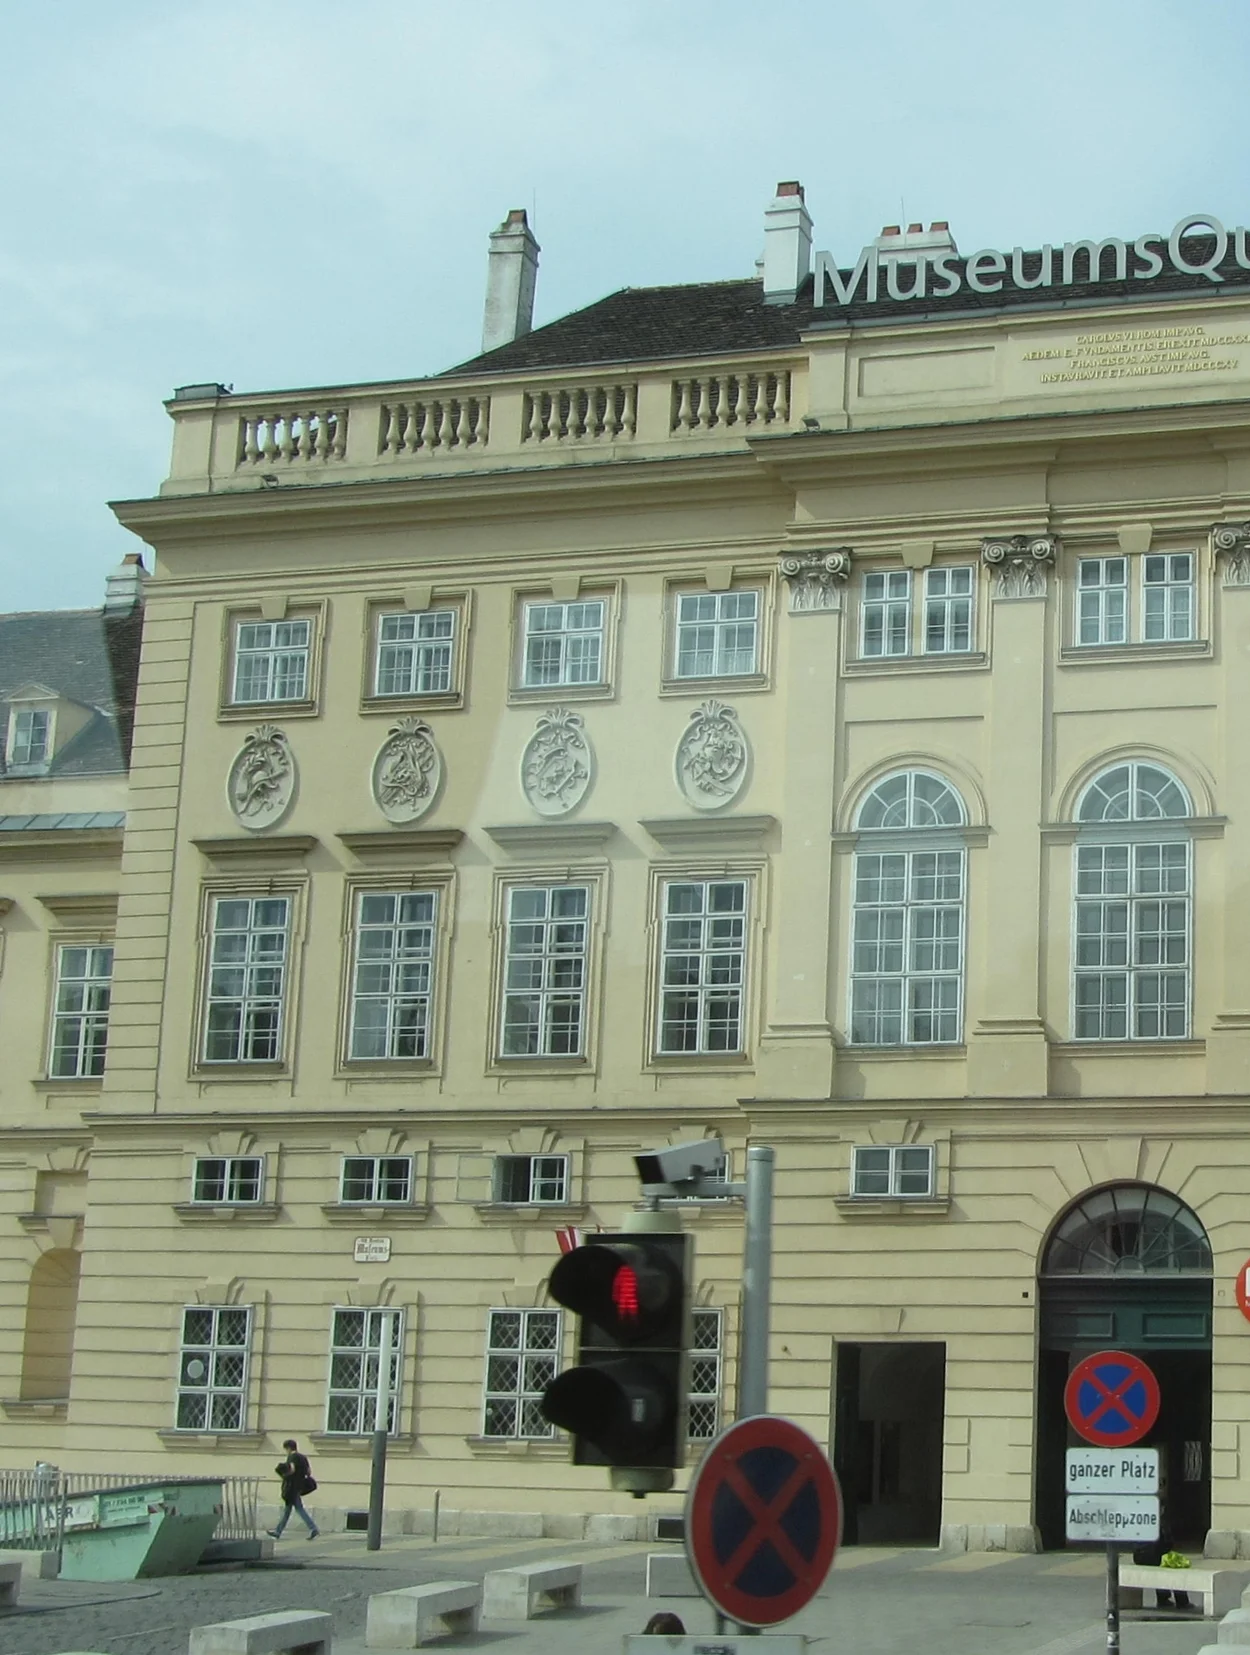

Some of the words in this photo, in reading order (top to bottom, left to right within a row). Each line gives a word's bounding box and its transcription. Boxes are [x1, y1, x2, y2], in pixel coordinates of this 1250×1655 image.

[1069, 1464, 1115, 1481] ganzer
[1121, 1461, 1156, 1478] Platz
[1069, 1509, 1157, 1528] Abschleppzone
